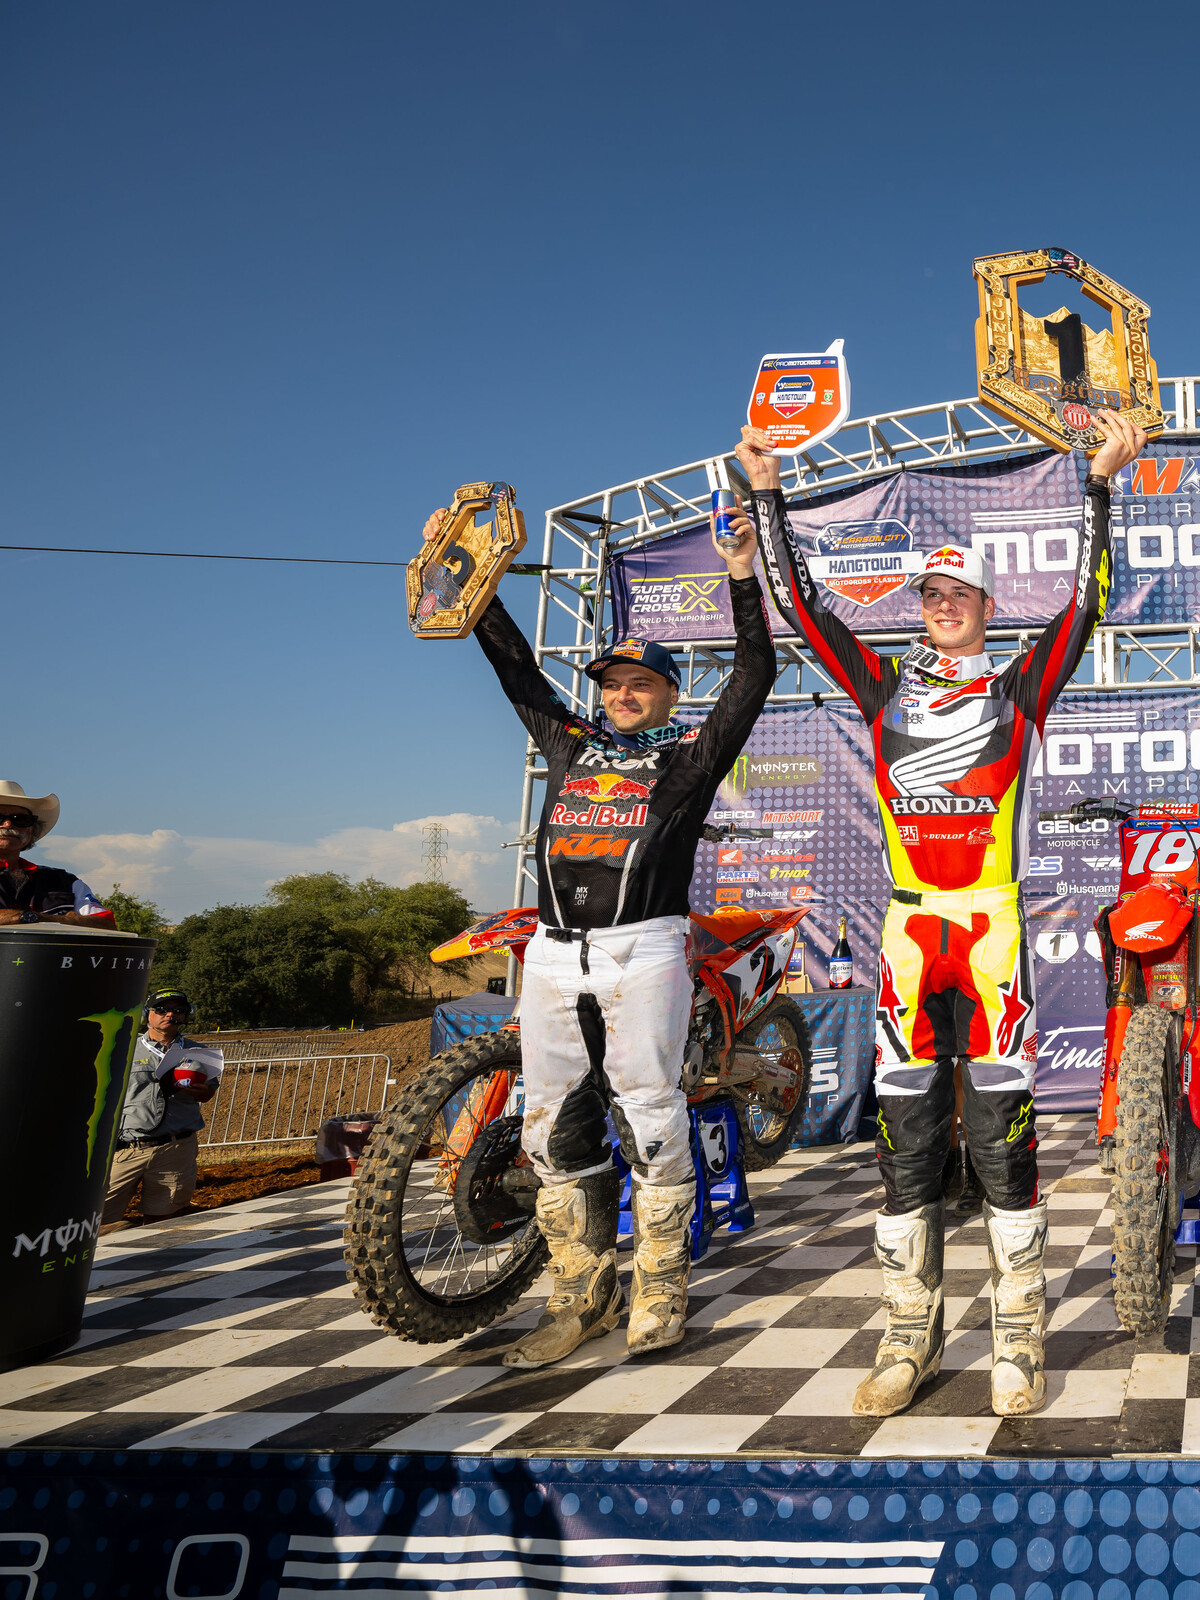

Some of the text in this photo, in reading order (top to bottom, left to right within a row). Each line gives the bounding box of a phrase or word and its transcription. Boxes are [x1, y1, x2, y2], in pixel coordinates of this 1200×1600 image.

[1044, 313, 1088, 403] 1
[1131, 330, 1146, 379] 2023
[776, 393, 807, 401] HANGTOWN
[841, 533, 908, 544] CARSON CITY
[840, 541, 886, 549] MOTORSPORTS
[828, 556, 903, 574] HANGTOWN
[925, 557, 965, 571] Red Bull
[463, 554, 495, 600] 2023
[828, 576, 904, 588] MOTOCROSS CLASSIC
[631, 584, 684, 595] SUPER
[634, 594, 681, 604] MOTO
[631, 602, 682, 614] CROSS
[632, 613, 725, 625] WORLD CHAMPIONSHIP
[900, 687, 931, 697] SHOWA
[576, 746, 661, 771] THOR
[751, 761, 817, 775] MONSTER
[890, 796, 999, 816] HONDA
[549, 803, 649, 827] Red Bull
[713, 810, 755, 820] GEICO
[1037, 817, 1109, 835] GEICO
[549, 833, 631, 857] KTM
[1047, 838, 1101, 848] MOTORCYCLE
[754, 853, 816, 864] LEGENDS
[716, 870, 759, 879] PARTS
[778, 869, 810, 879] THOR
[754, 890, 788, 900] Husqvarna
[1124, 934, 1164, 942] HONDA
[750, 945, 783, 998] 2
[1037, 1026, 1106, 1076] Fina
[708, 1123, 727, 1174] 3
[12, 1211, 102, 1258] MONS
